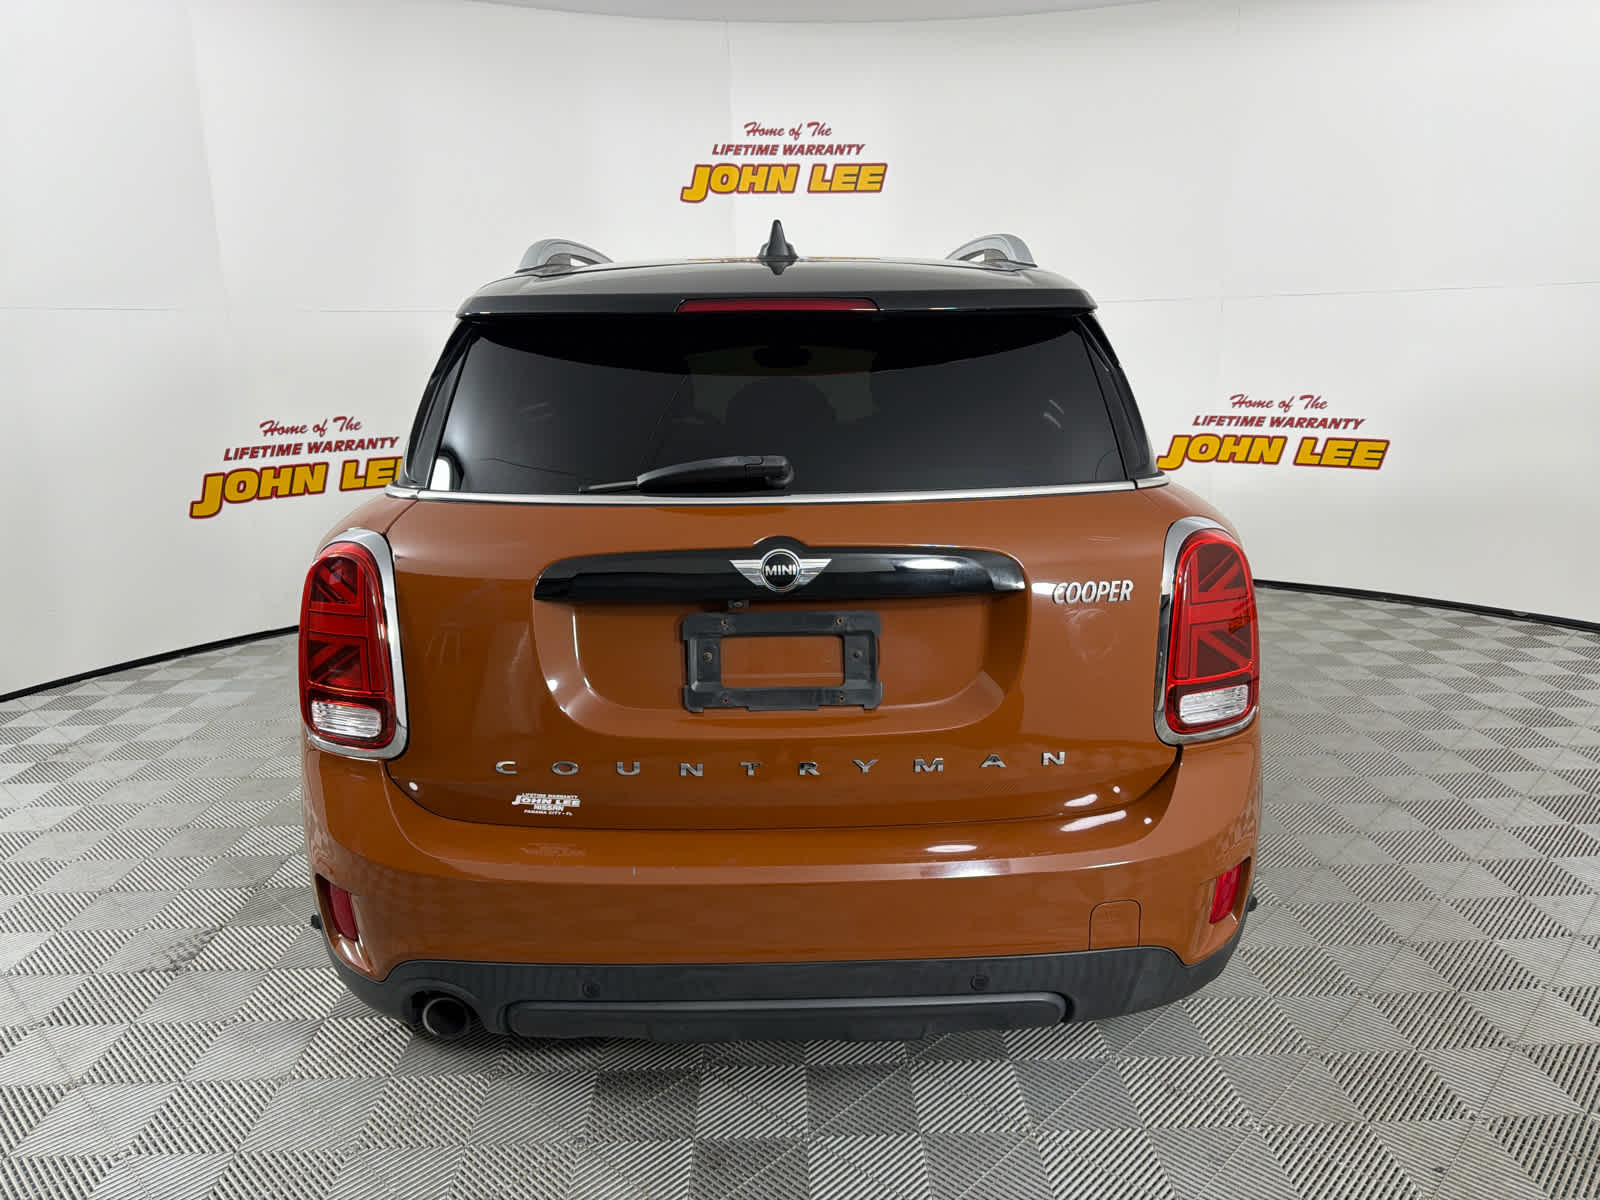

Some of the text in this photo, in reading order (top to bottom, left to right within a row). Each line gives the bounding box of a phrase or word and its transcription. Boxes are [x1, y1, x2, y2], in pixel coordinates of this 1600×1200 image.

[744, 121, 832, 140] Home of The
[712, 144, 866, 156] LIFETIME WARRANTY
[680, 163, 888, 203] JOHN LEE
[1230, 393, 1328, 413] Home of The
[259, 416, 362, 437] Home of The
[1192, 415, 1366, 430] LIFETIME WARRANTY
[223, 436, 400, 461] LIFETIME WARRANTY
[1156, 433, 1390, 471] JOHN LEE
[189, 456, 403, 519] JOHN LE
[765, 564, 796, 576] MINI
[1052, 580, 1134, 604] COOPER
[495, 751, 1066, 777] COUNTRYMAN
[512, 795, 581, 807] JOHN LEE
